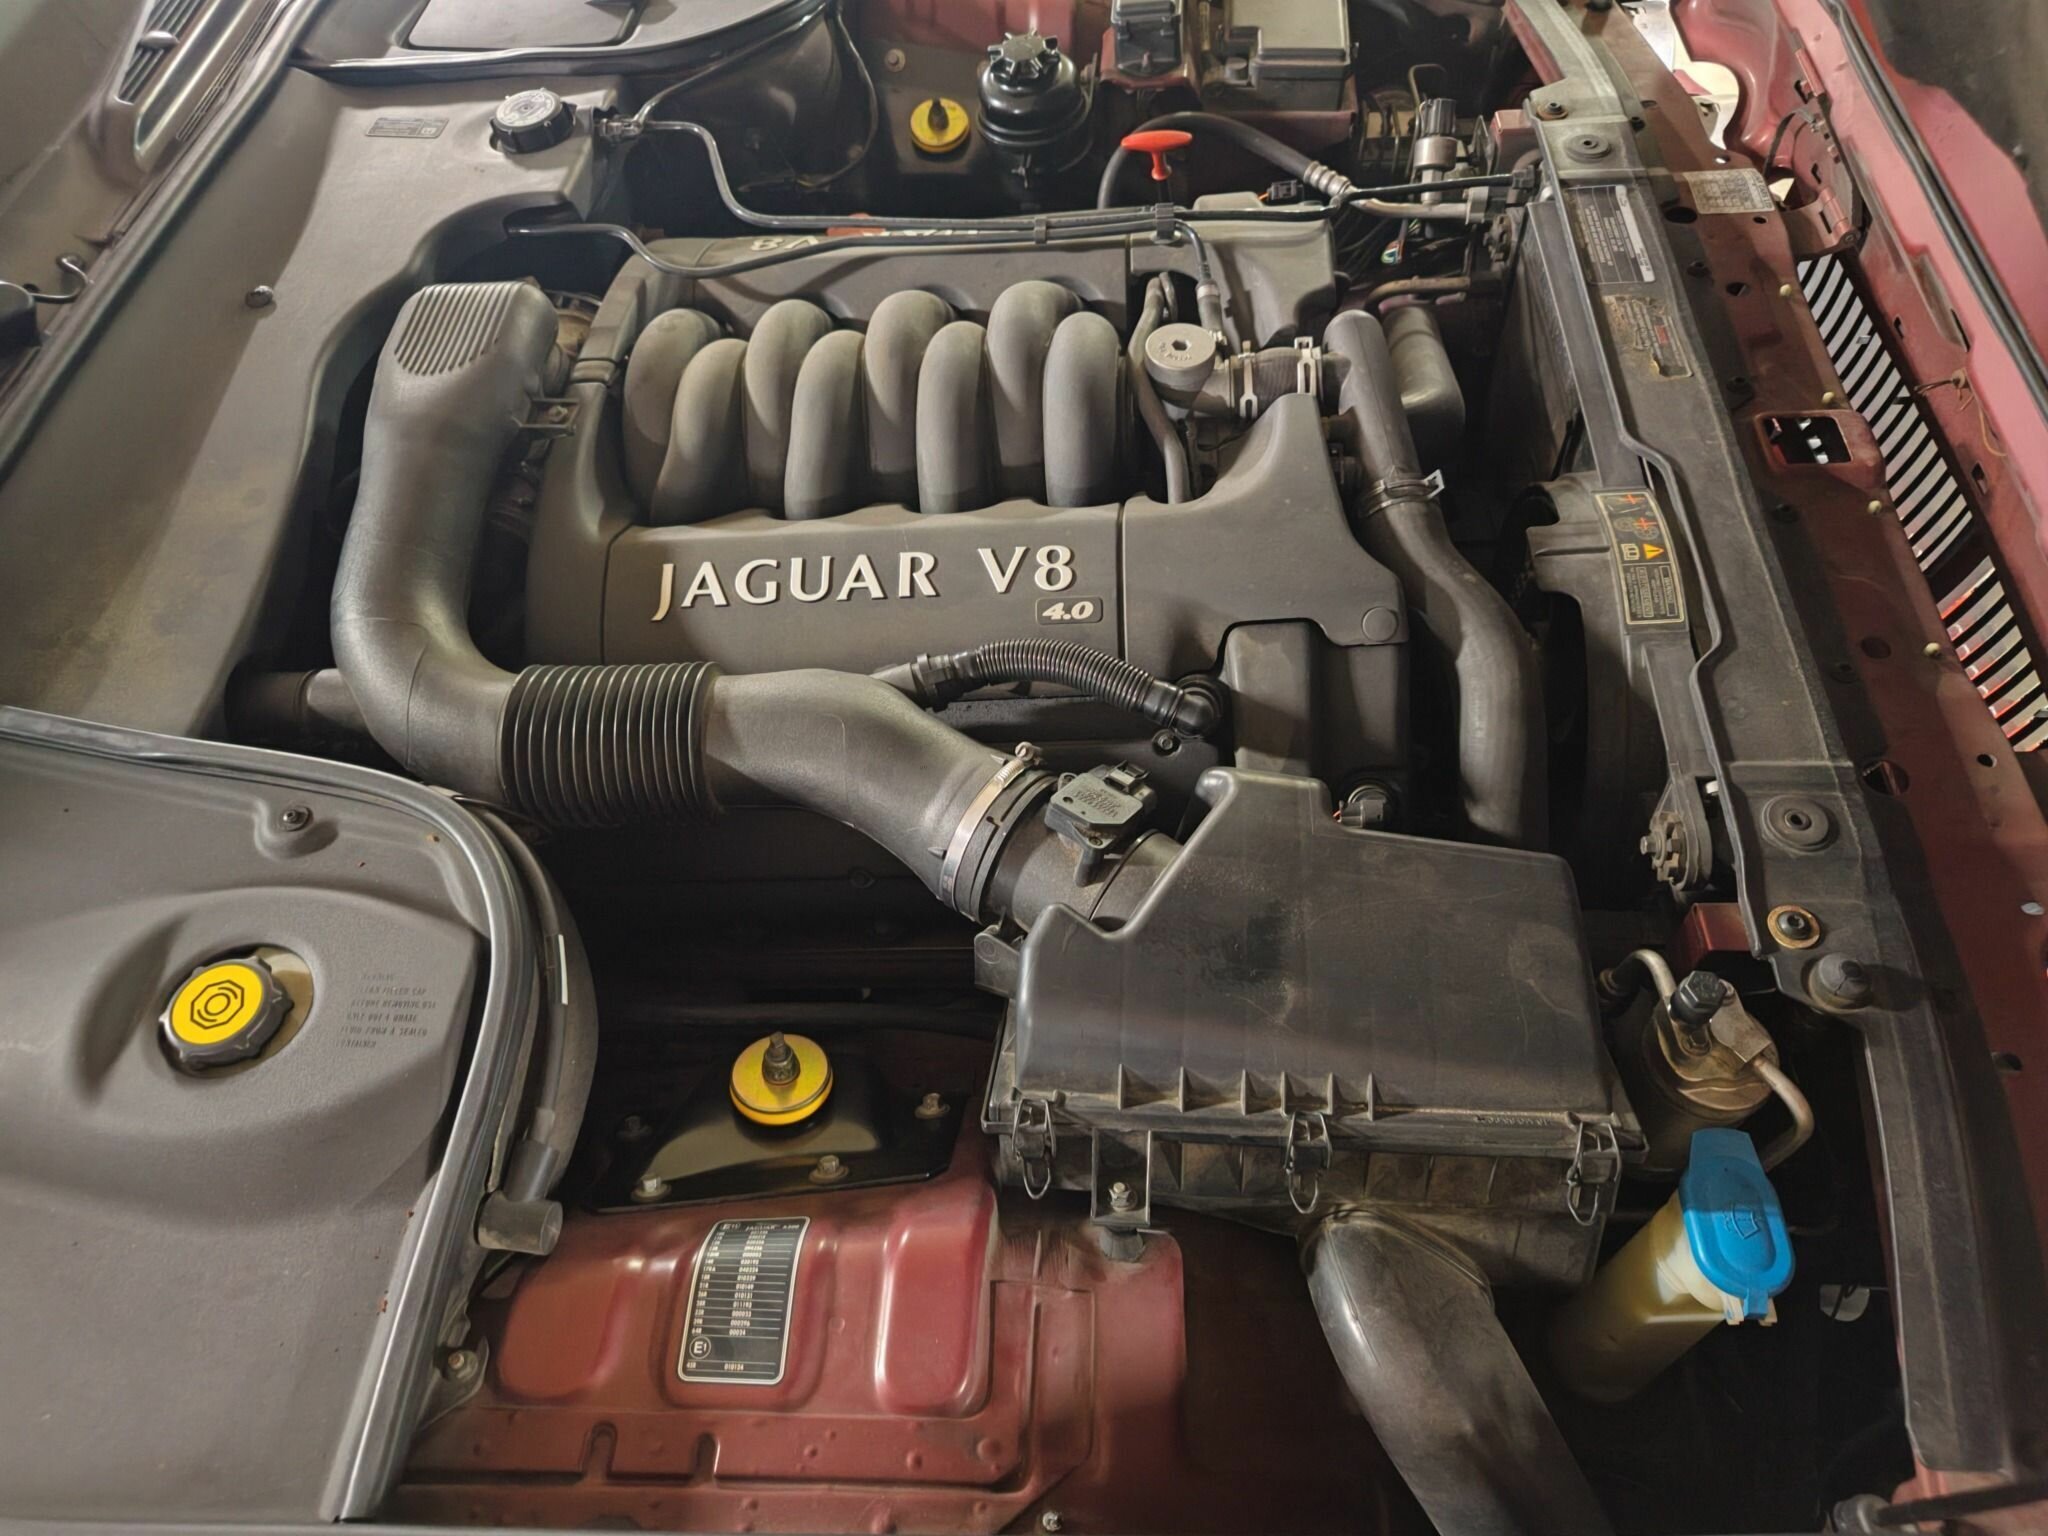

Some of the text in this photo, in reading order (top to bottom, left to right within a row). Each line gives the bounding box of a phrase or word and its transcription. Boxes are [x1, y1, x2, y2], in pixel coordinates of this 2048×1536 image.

[651, 544, 1077, 622] JAGUAR V8
[1041, 600, 1095, 621] 4.0
